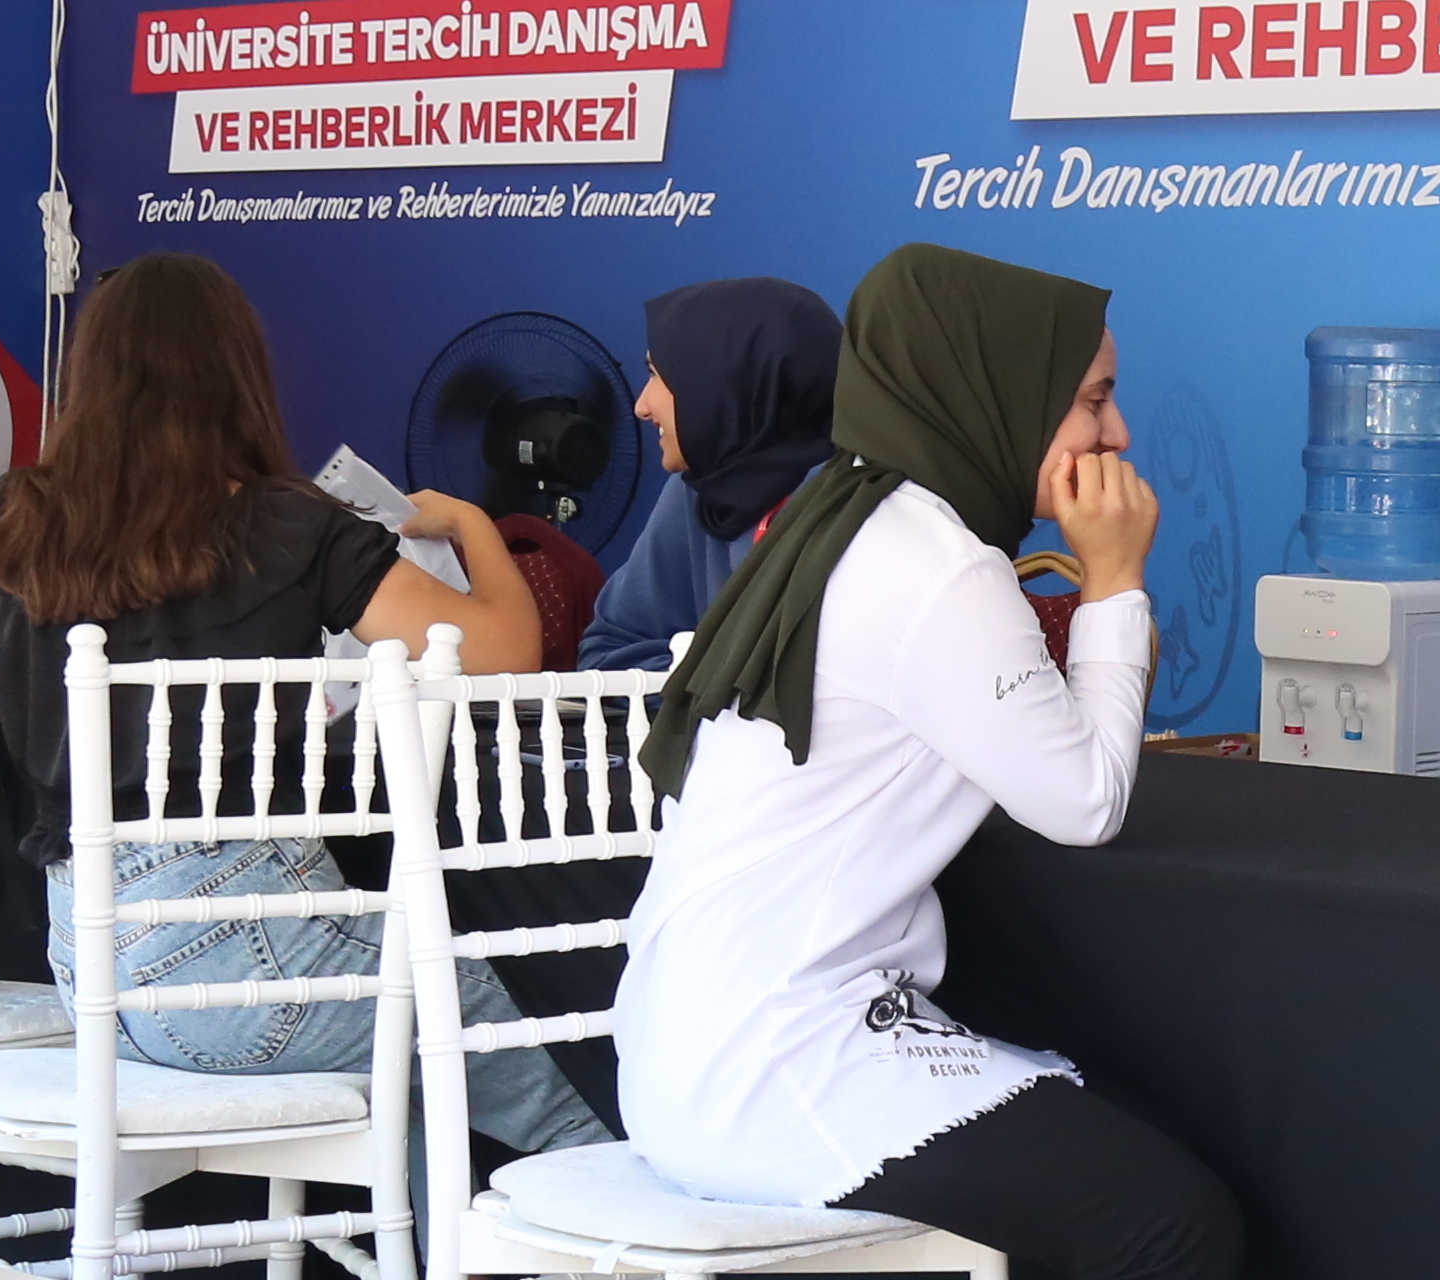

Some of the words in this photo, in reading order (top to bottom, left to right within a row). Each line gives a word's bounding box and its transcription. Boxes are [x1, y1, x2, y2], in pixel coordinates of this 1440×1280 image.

[146, 10, 354, 75] ÜNİVERSİTE
[359, 0, 500, 64] TERCİH
[508, 2, 708, 61] DANIŞMA
[1072, 7, 1177, 85] VE
[194, 110, 240, 153] VE
[248, 90, 450, 152] REHBERLİK
[459, 82, 638, 146] MERKEZİ
[137, 187, 194, 224] Tercih
[199, 187, 363, 224] Danışmanlarımız
[367, 194, 393, 222] ve
[398, 182, 565, 221] Rehberlerimizle
[570, 177, 717, 227] Yanınızdayız
[913, 144, 1041, 210] Tercih
[906, 1045, 988, 1060] ADVENTURE
[929, 1063, 981, 1078] BEGINS
